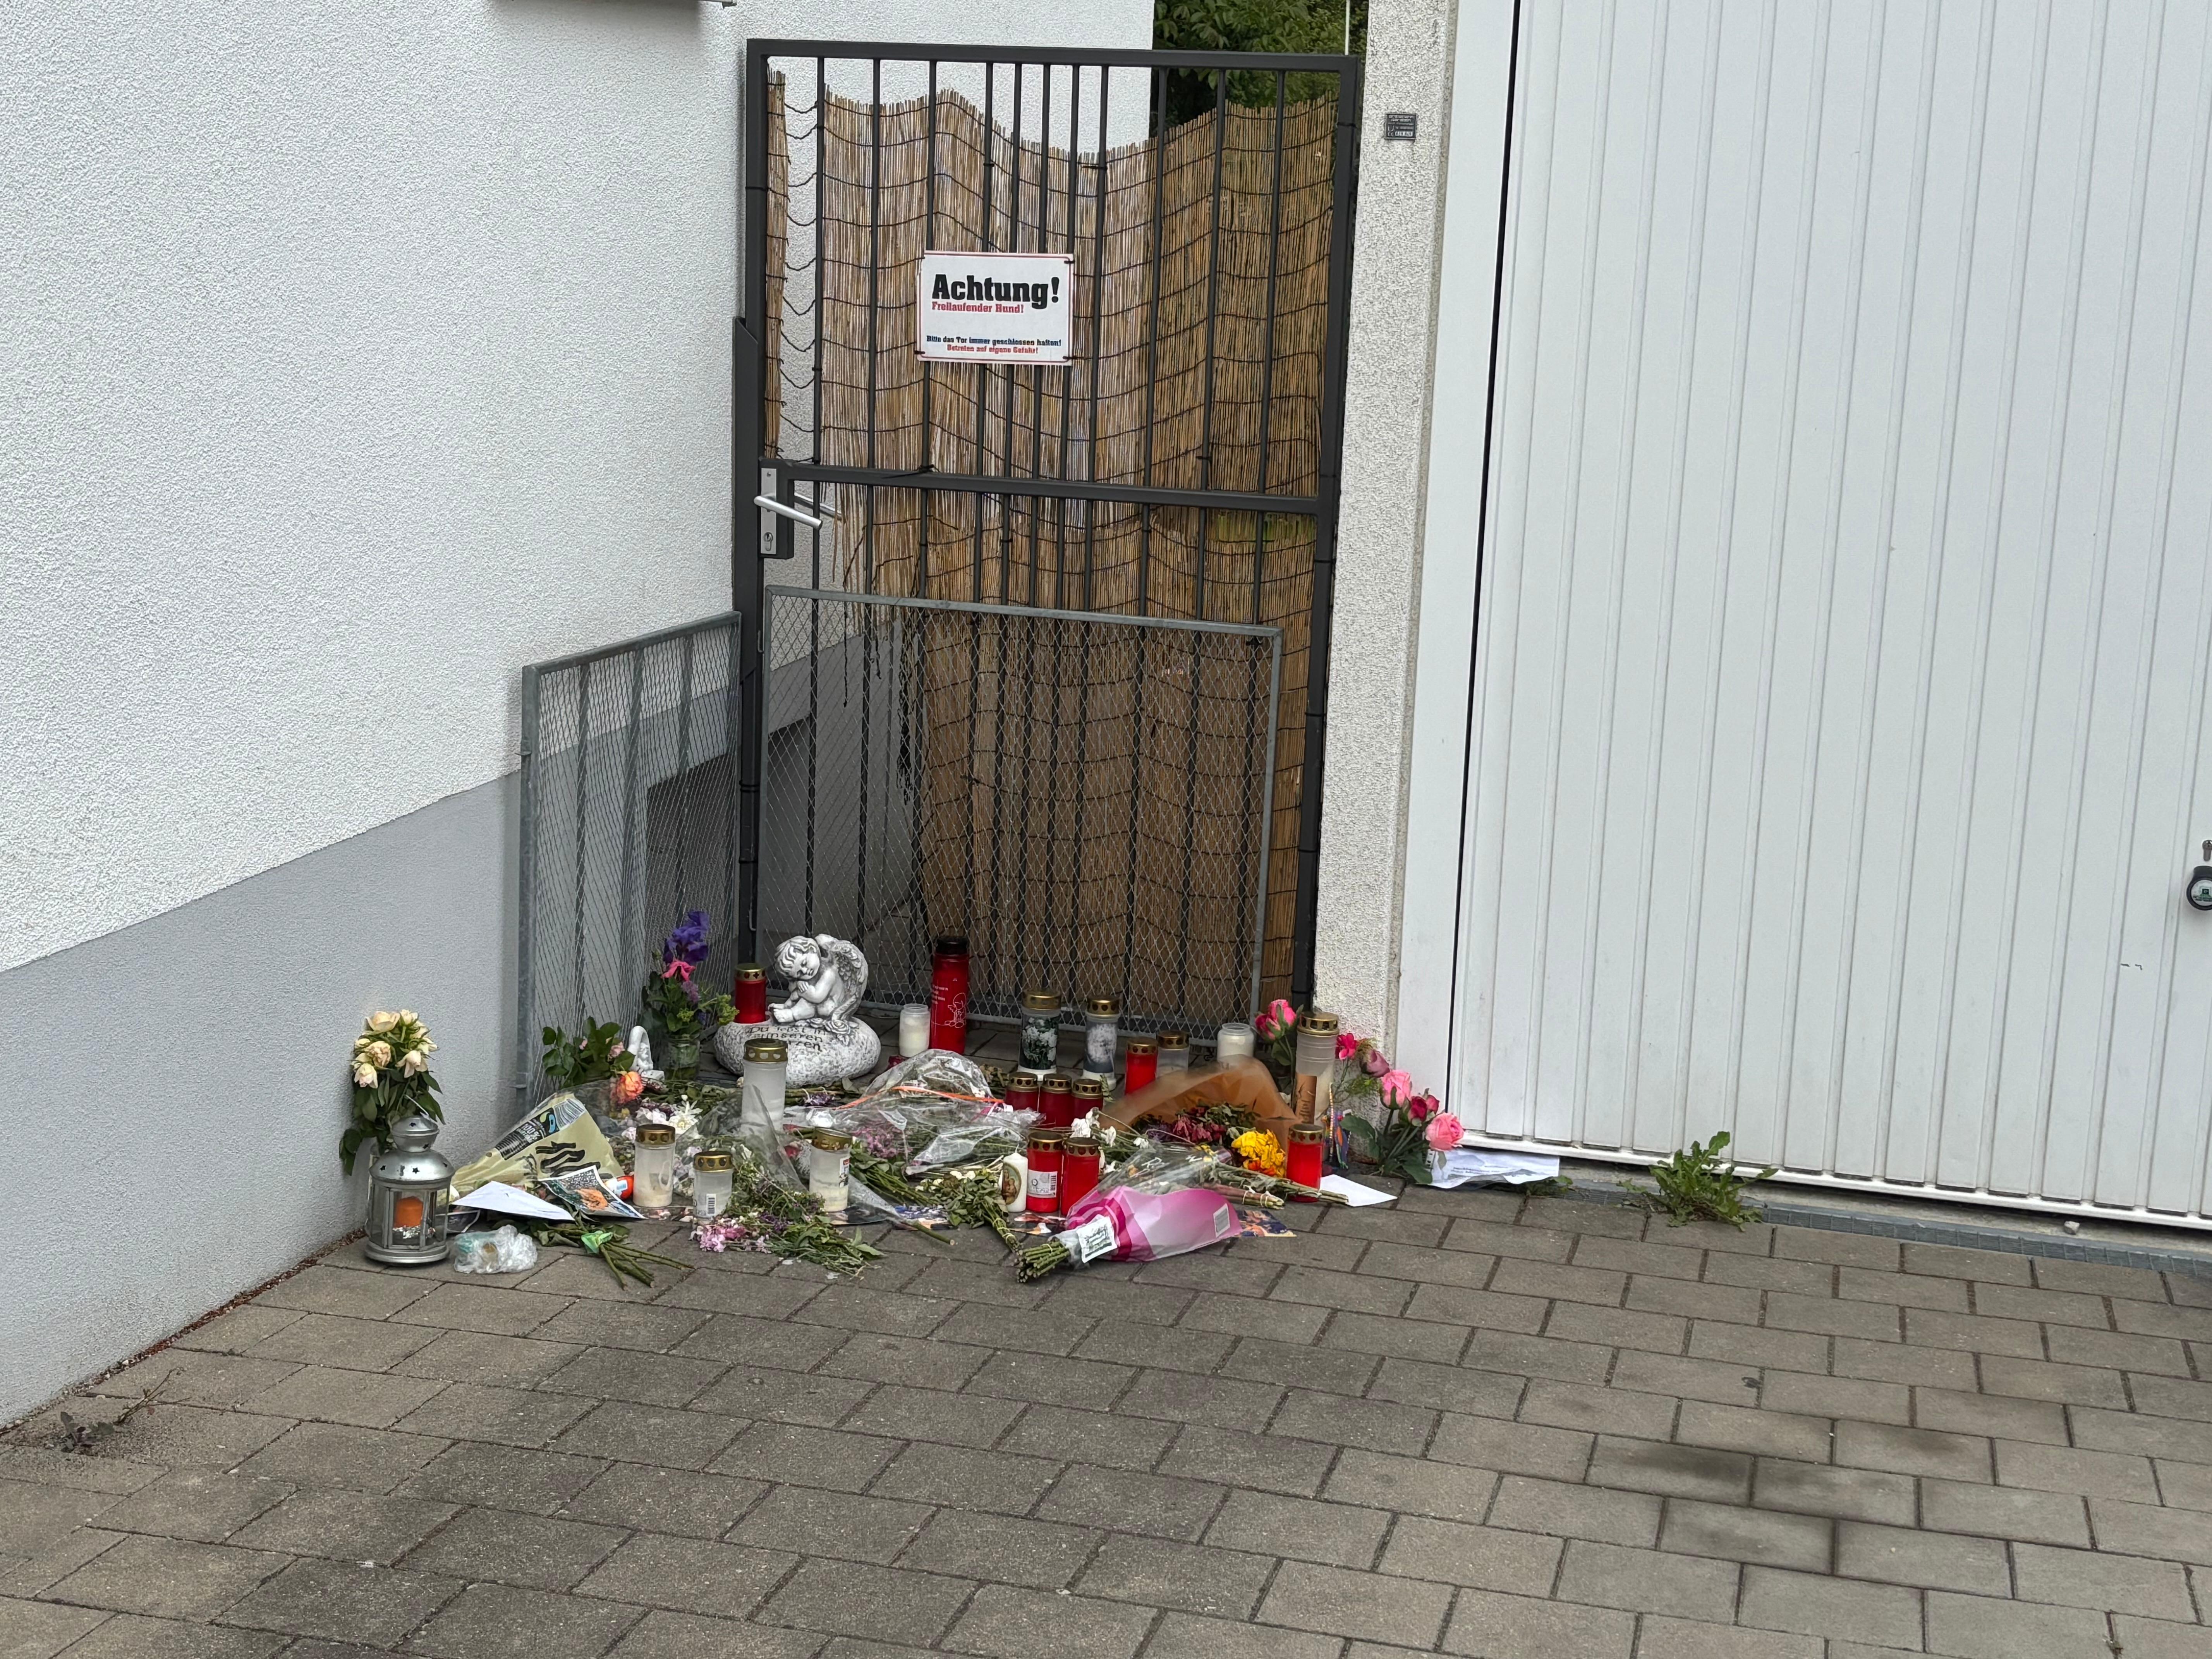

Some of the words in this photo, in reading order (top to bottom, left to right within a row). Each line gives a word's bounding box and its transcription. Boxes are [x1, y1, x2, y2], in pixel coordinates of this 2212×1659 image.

[931, 274, 1060, 309] Achtung!
[932, 301, 993, 313] Freilaufender
[995, 303, 1024, 313] Hund!
[992, 338, 1035, 346] geschlossen
[989, 346, 1012, 354] eigene
[761, 1032, 823, 1042] unseren
